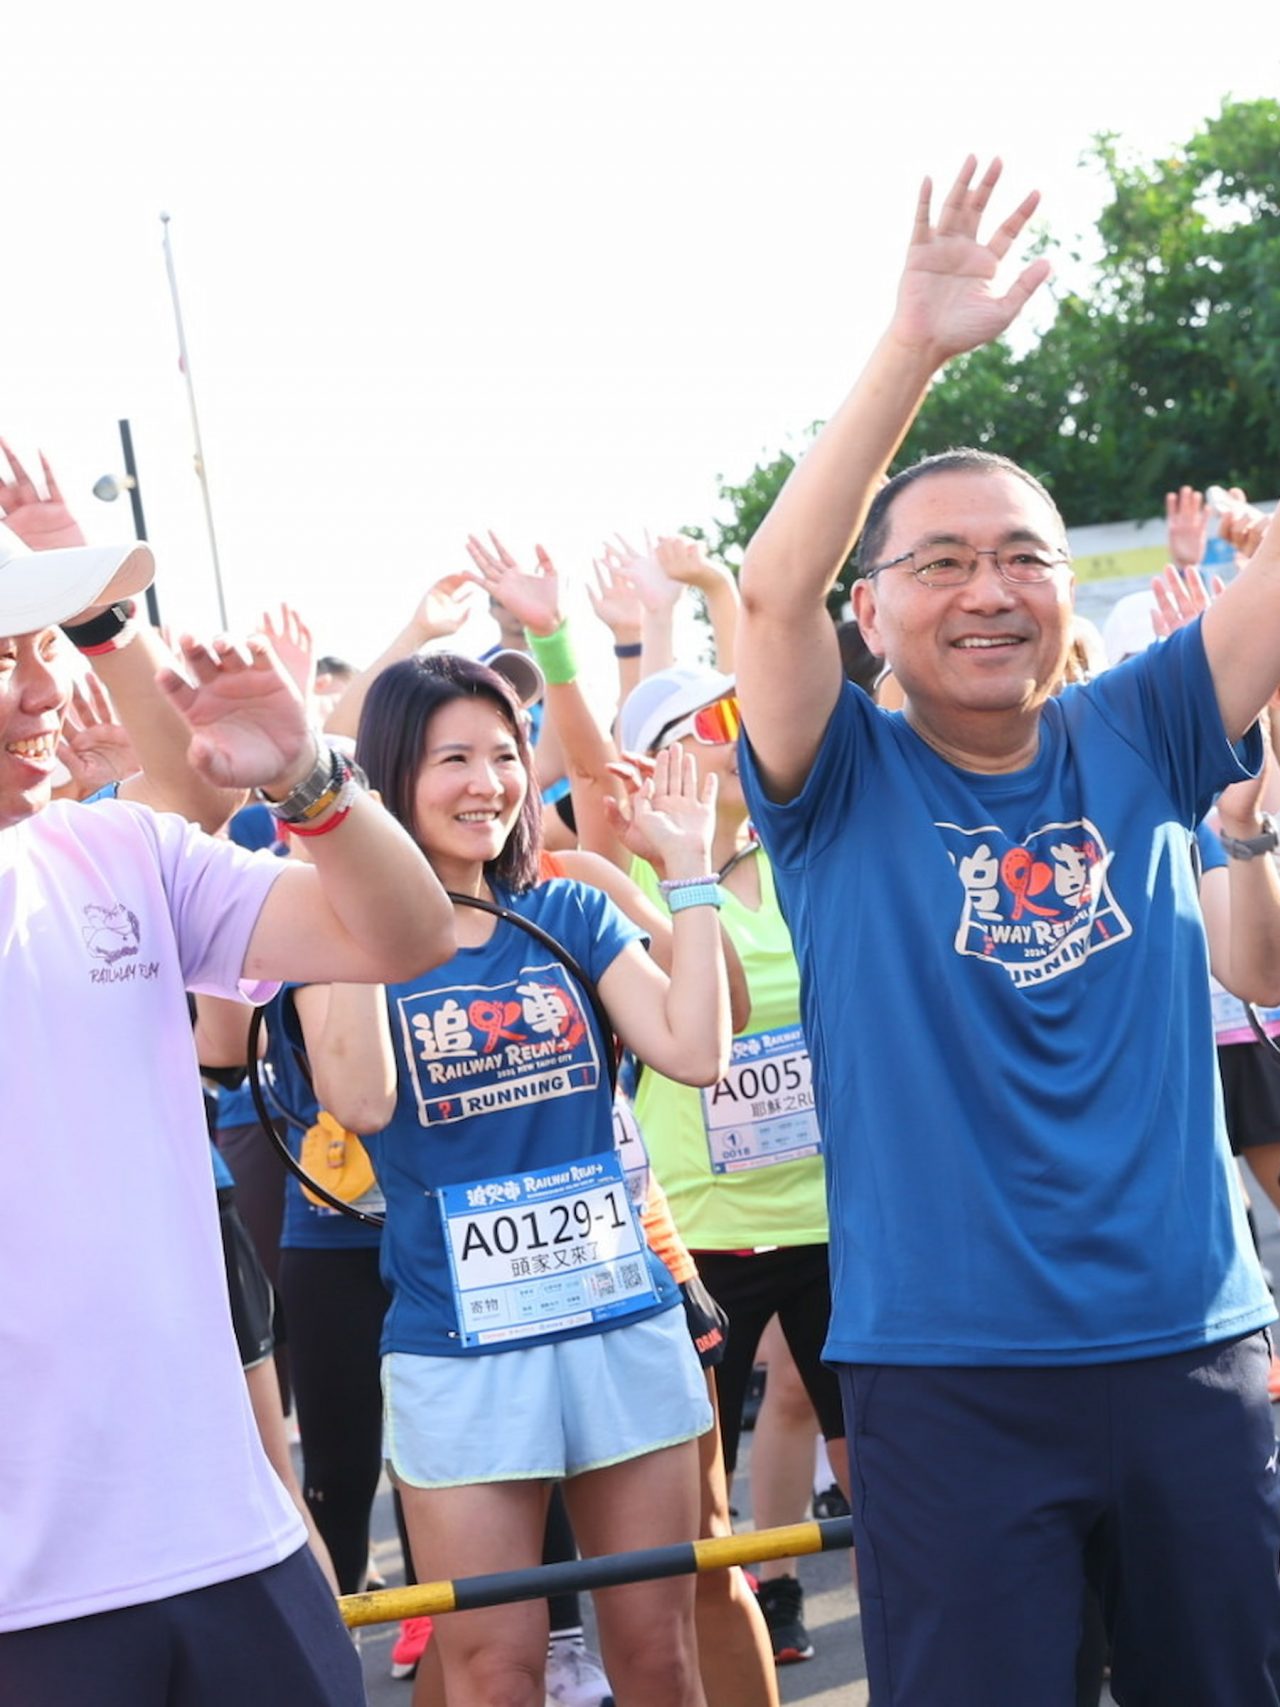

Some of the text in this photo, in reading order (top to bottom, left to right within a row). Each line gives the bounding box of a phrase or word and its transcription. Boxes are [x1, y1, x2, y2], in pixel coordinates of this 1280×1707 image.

[427, 1038, 557, 1084] RAILWAY RELAY
[712, 1054, 809, 1105] A005
[468, 1076, 564, 1112] RUNNING
[523, 1171, 570, 1192] RAILWAY
[461, 1191, 627, 1261] A0129-1
